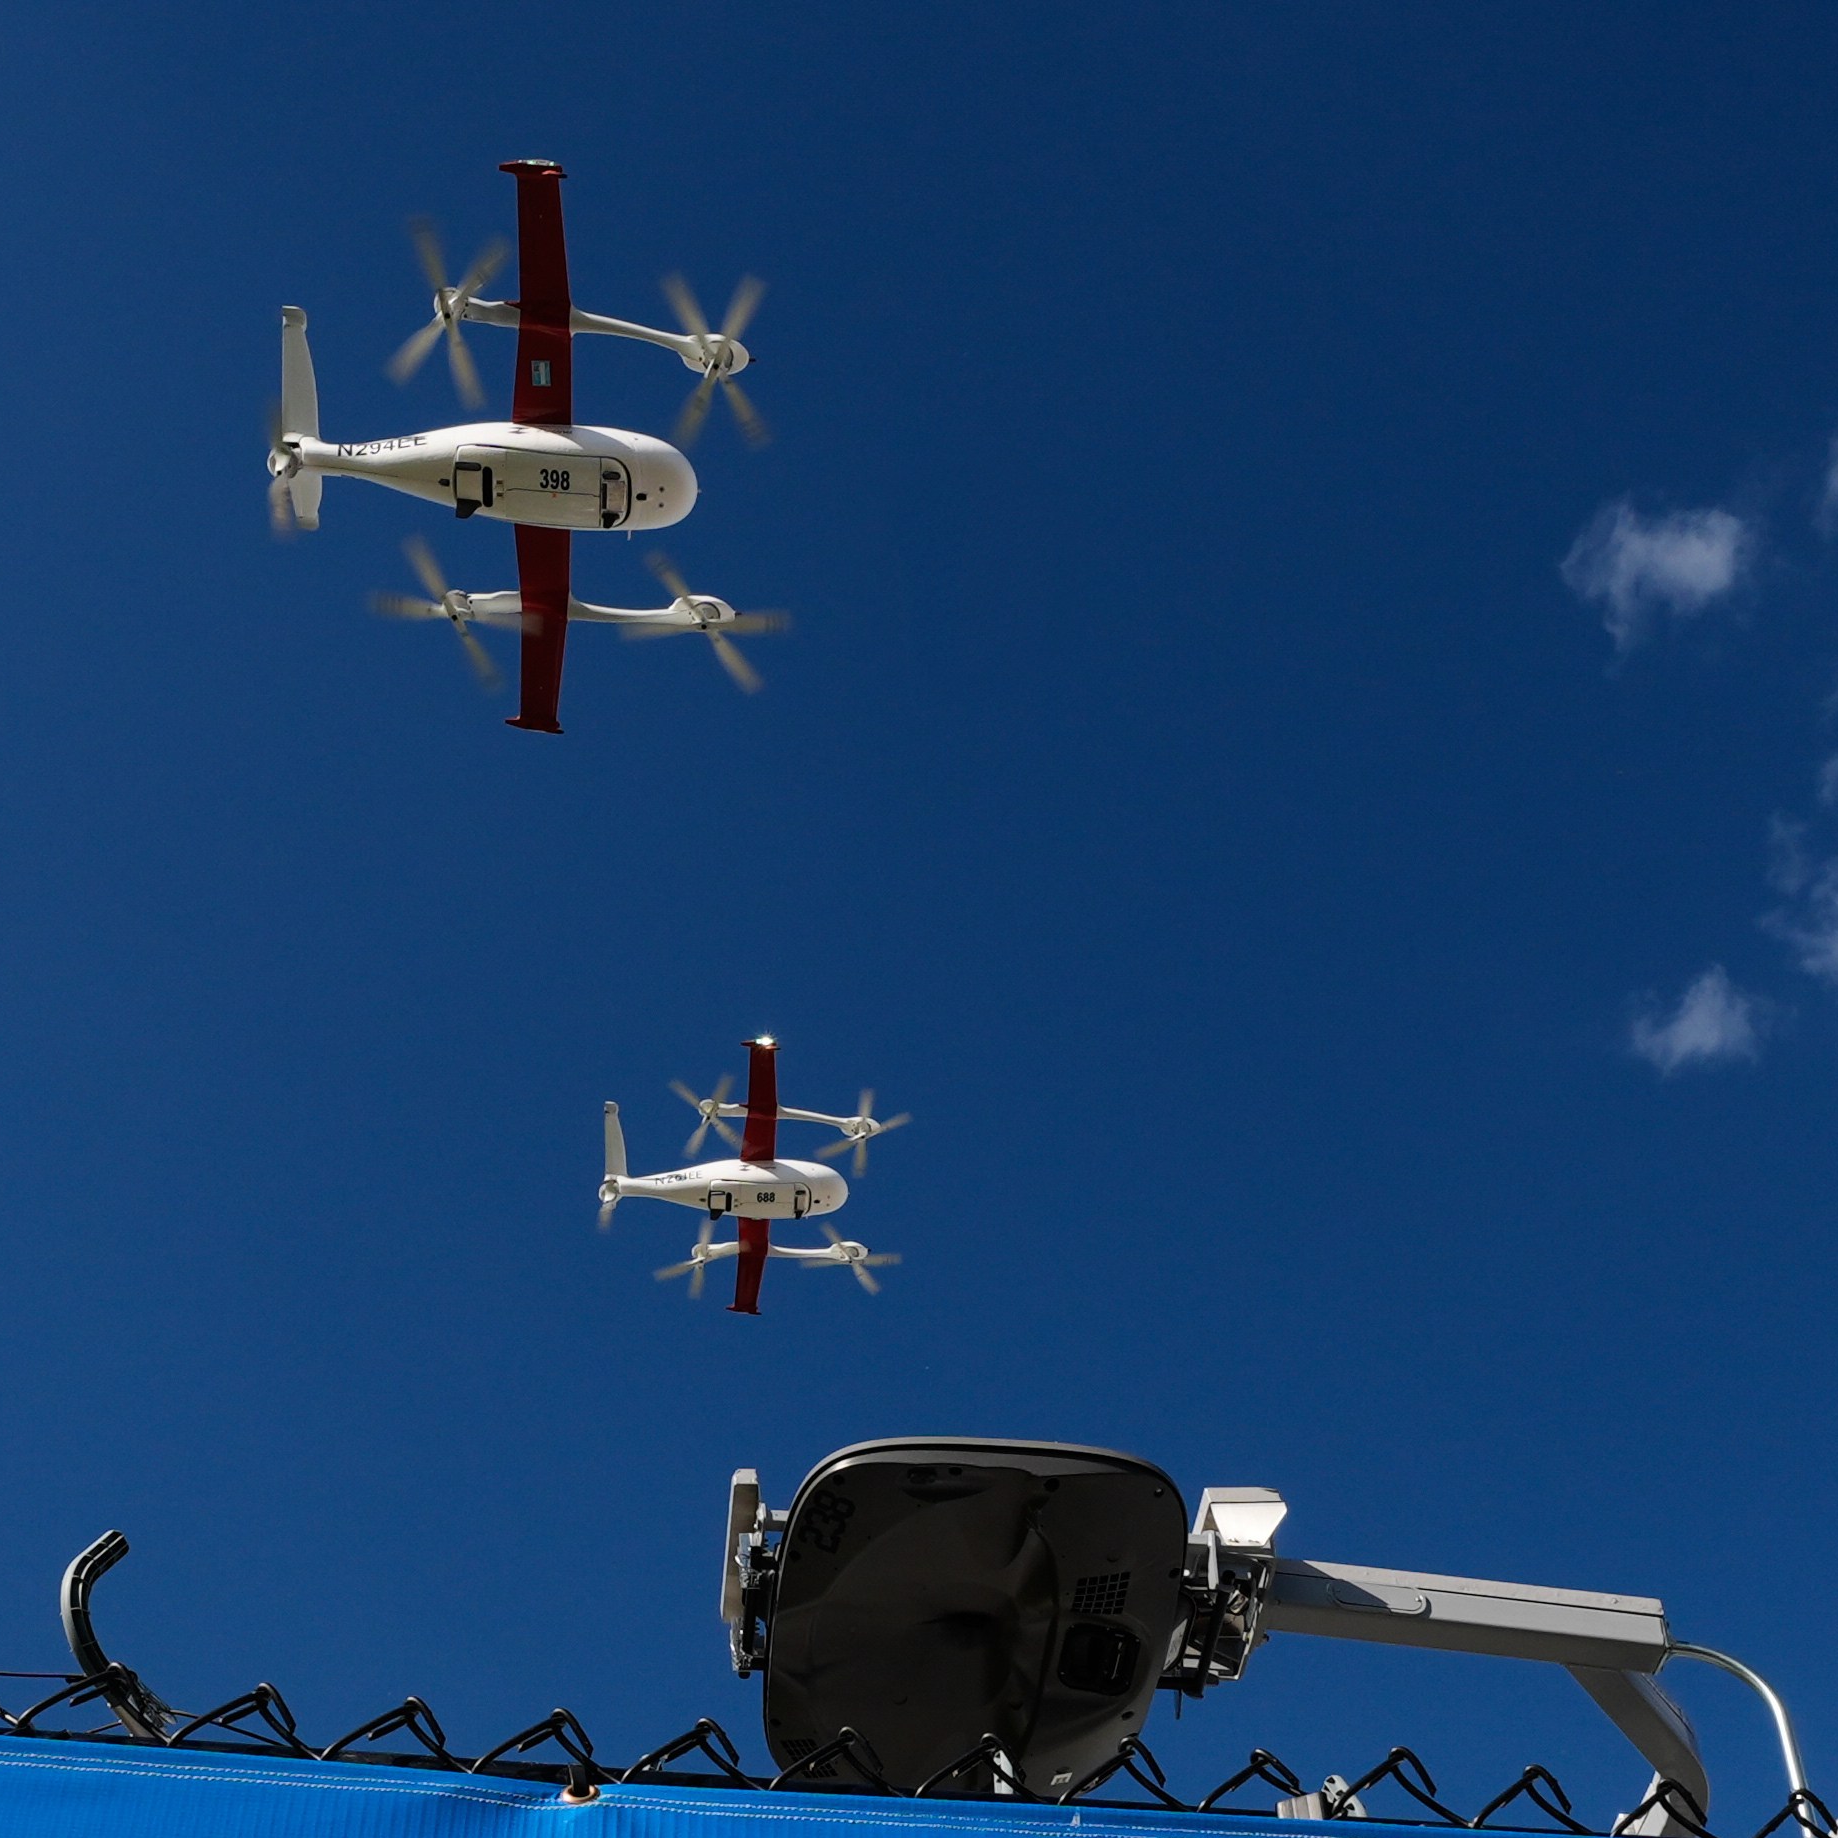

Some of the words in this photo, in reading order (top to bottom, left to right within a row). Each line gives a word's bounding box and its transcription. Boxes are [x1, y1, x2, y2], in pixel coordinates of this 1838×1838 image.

[337, 435, 428, 457] N294EE
[539, 468, 571, 491] 398
[756, 1191, 776, 1203] 688
[798, 1489, 856, 1555] 238
